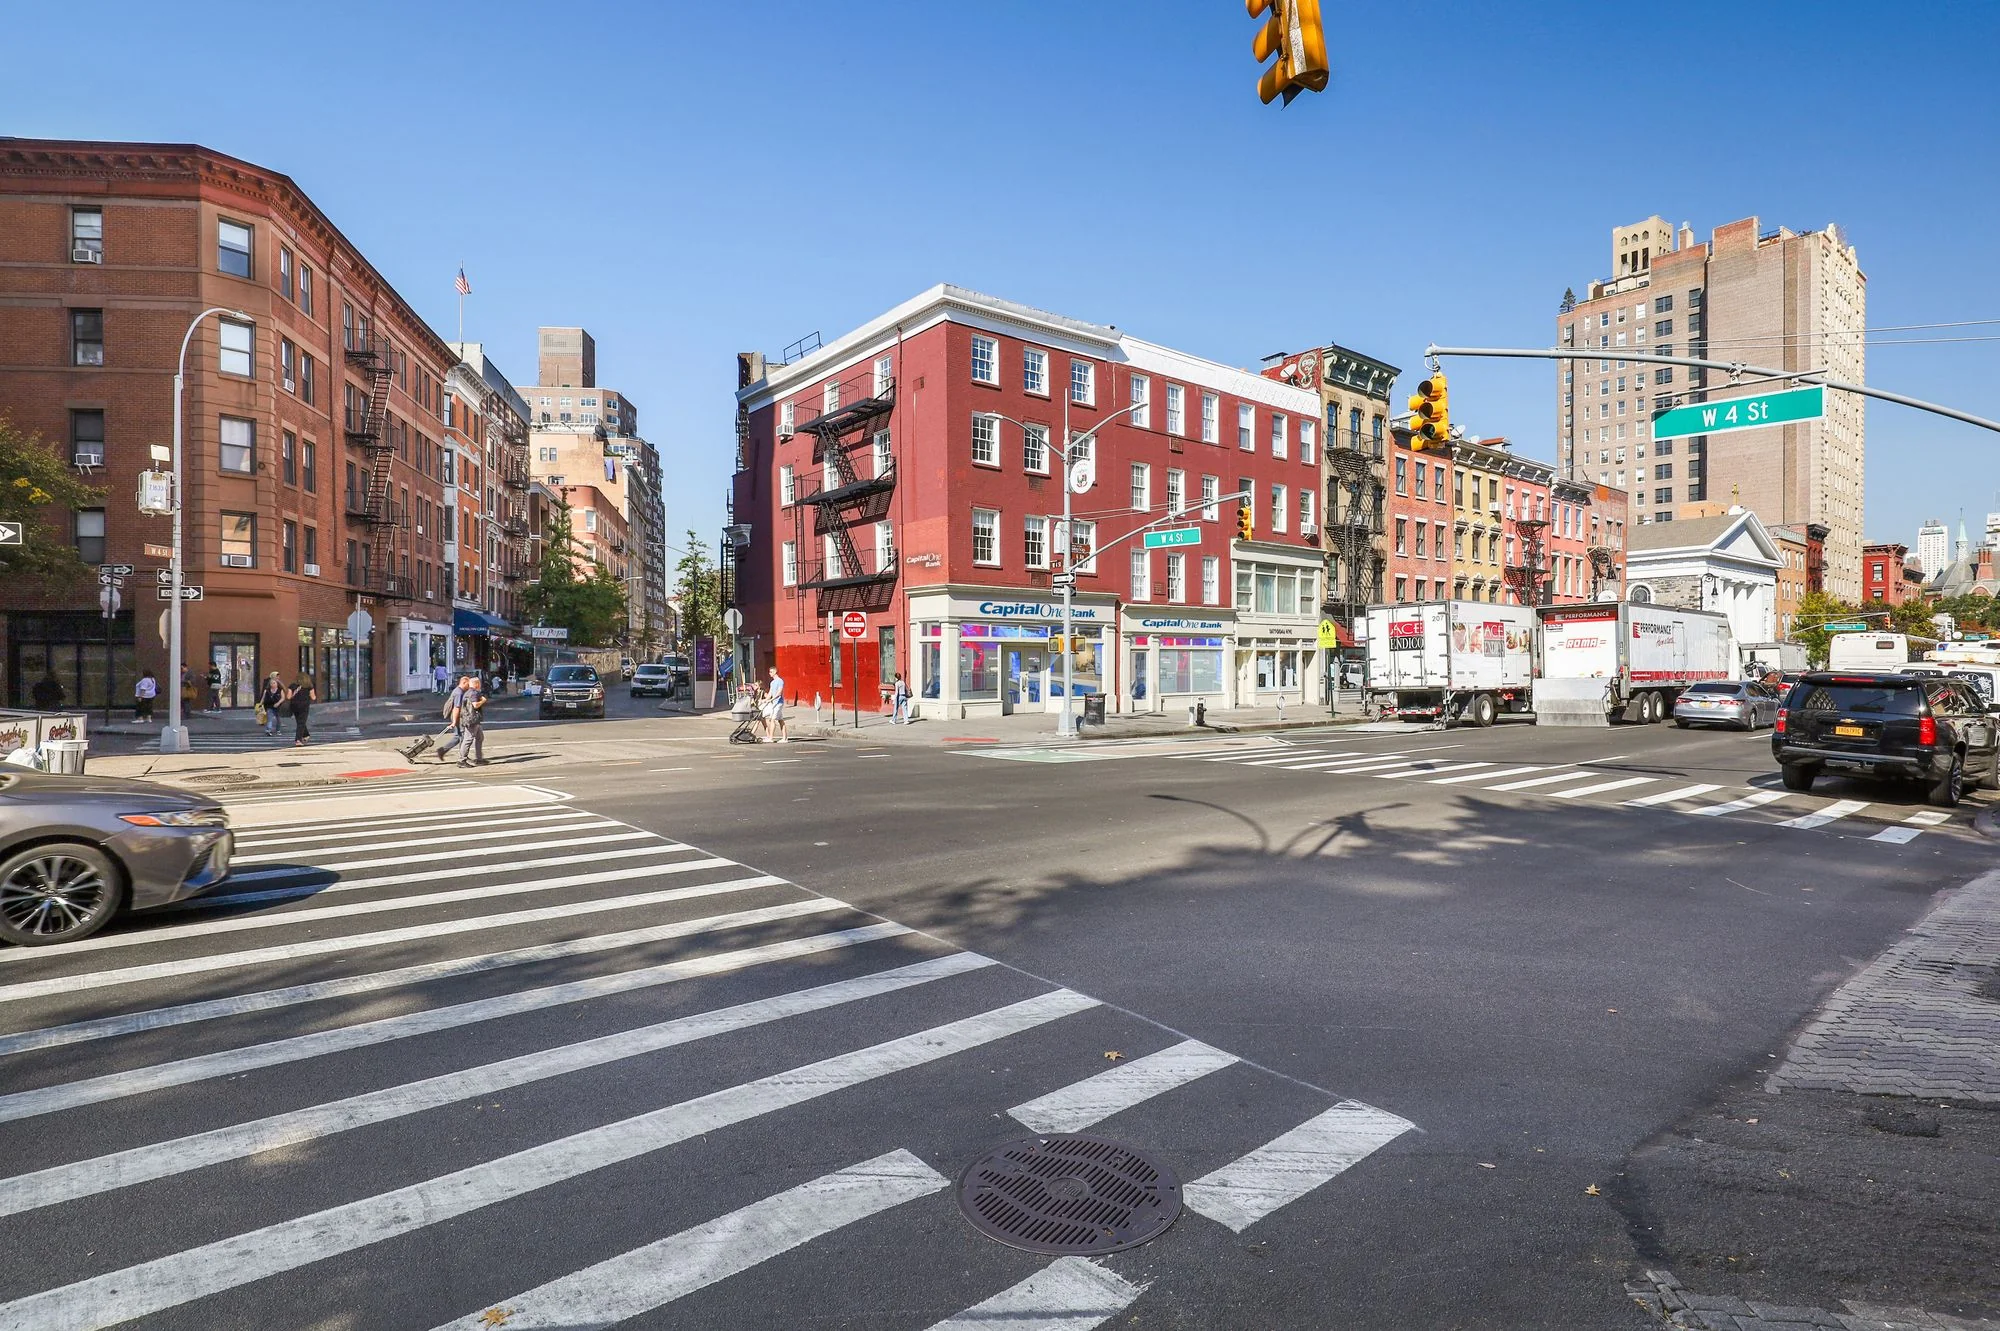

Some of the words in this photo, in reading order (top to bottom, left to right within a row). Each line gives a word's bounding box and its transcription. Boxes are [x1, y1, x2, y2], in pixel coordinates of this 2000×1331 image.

[1702, 408, 1717, 427] W
[1725, 405, 1737, 423] 4
[1748, 400, 1768, 421] St
[1161, 534, 1167, 544] W
[1168, 533, 1174, 543] 4
[1175, 532, 1184, 543] St
[164, 588, 172, 596] ON
[182, 588, 195, 596] WAY
[1565, 611, 1609, 619] PERFORMANCE
[1390, 623, 1424, 636] ACE
[1484, 625, 1505, 638] ACE
[1640, 622, 1672, 635] PERFORMANCE
[1390, 636, 1424, 650] ENDICO
[1566, 638, 1598, 648] ROMA
